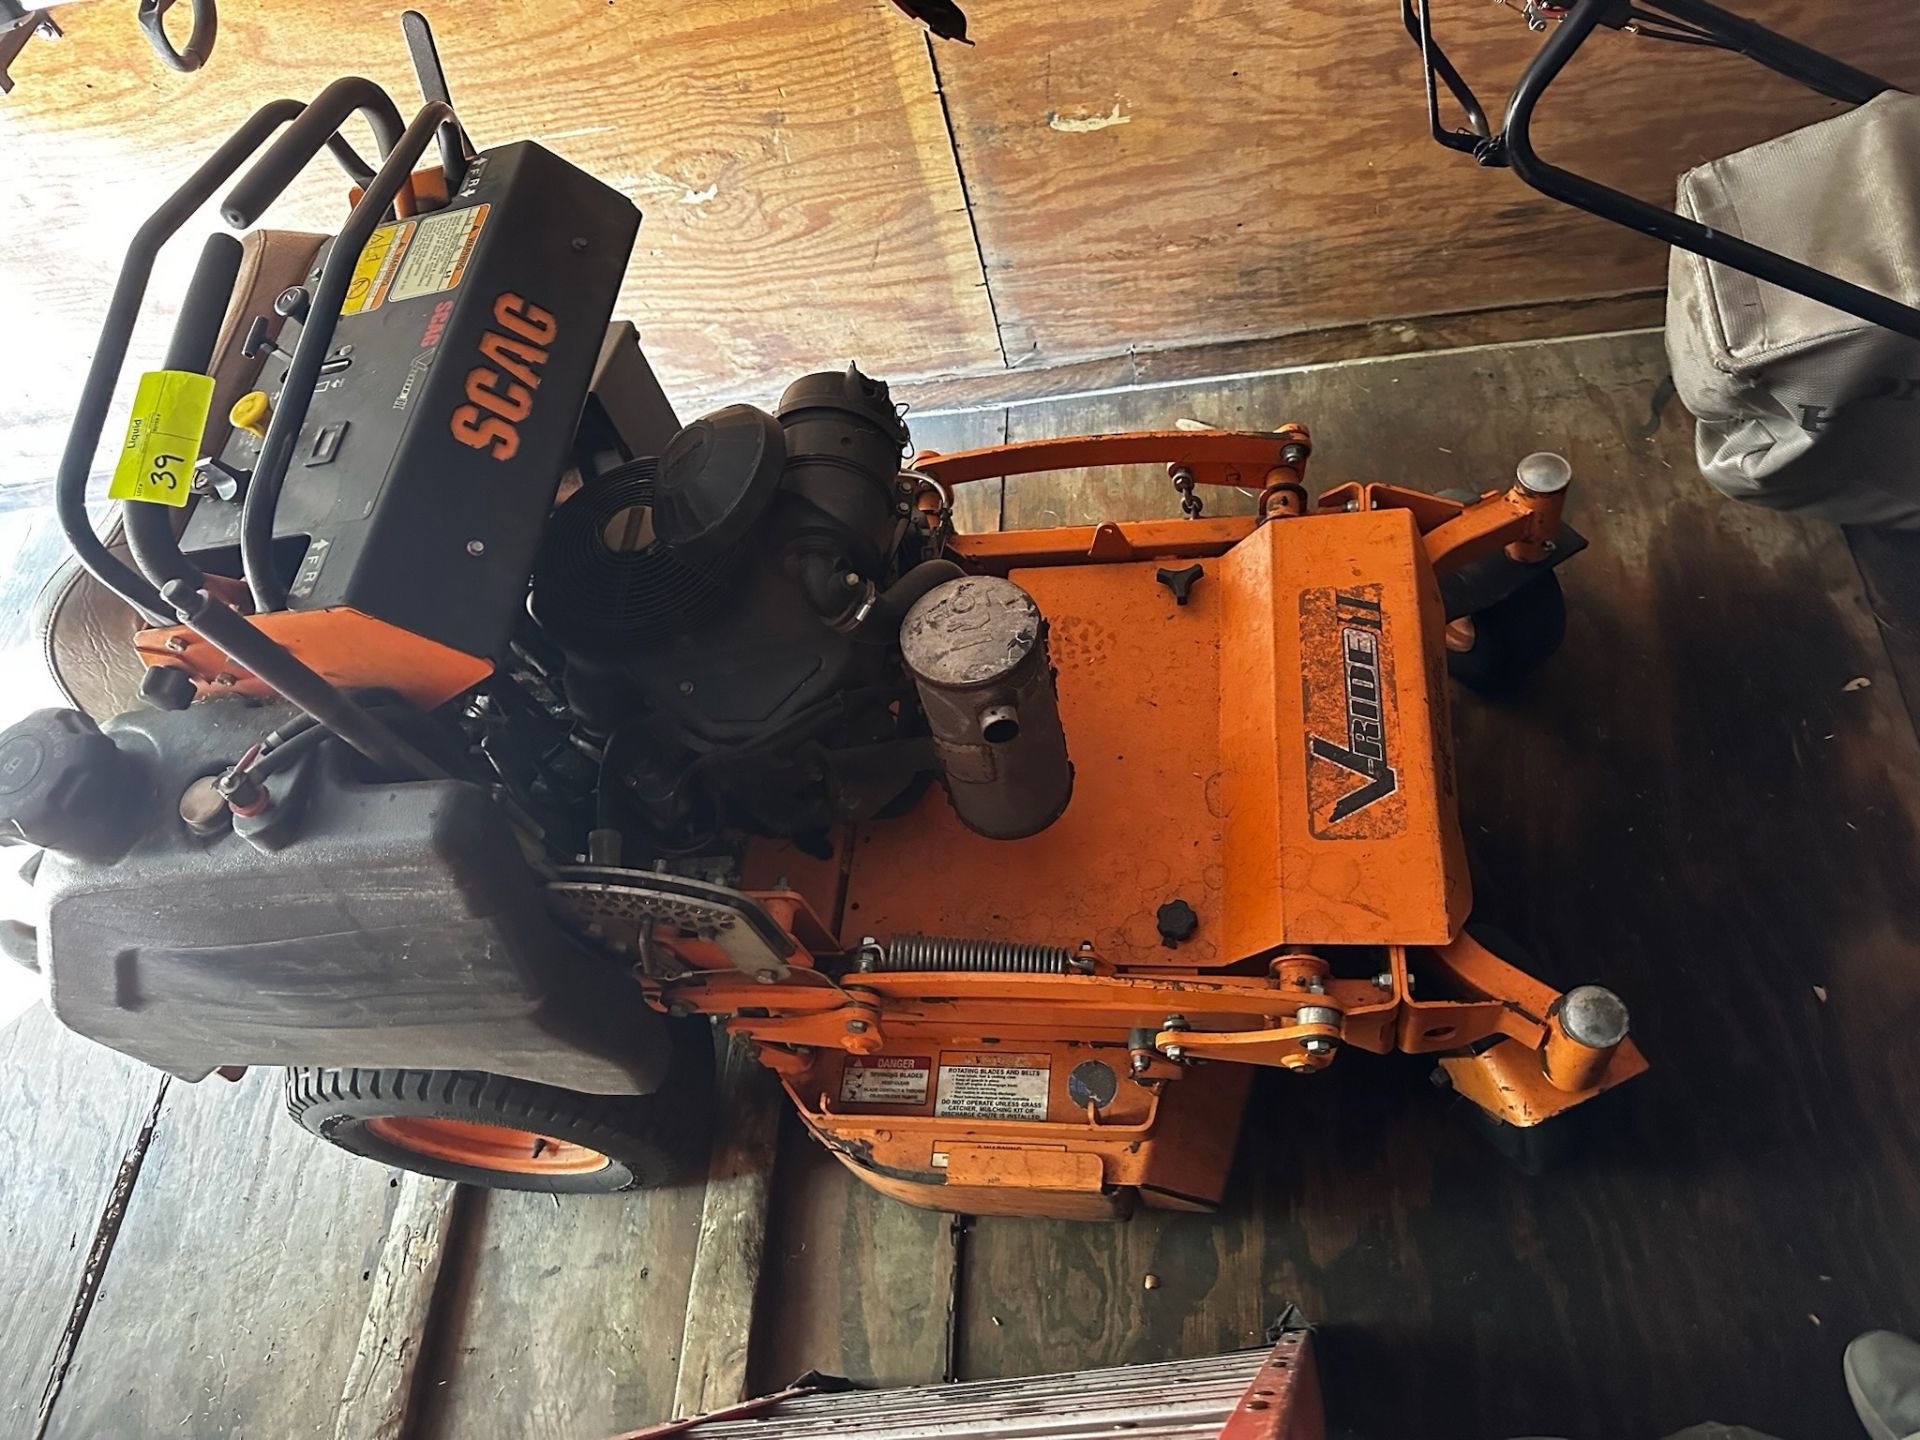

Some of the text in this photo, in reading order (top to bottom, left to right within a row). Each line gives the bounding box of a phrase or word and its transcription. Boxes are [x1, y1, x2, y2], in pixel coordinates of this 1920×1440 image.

[468, 177, 480, 187] R
[449, 290, 558, 462] SCAG
[127, 419, 142, 449] Liquid
[150, 454, 185, 490] 39
[303, 555, 320, 582] F R
[878, 1058, 915, 1069] DANGER
[948, 1067, 979, 1075] ROTATING
[980, 1068, 1005, 1076] BLADES
[1021, 1069, 1041, 1077] BELTS
[966, 1099, 993, 1107] OPERATE
[995, 1100, 1020, 1108] UNLESS
